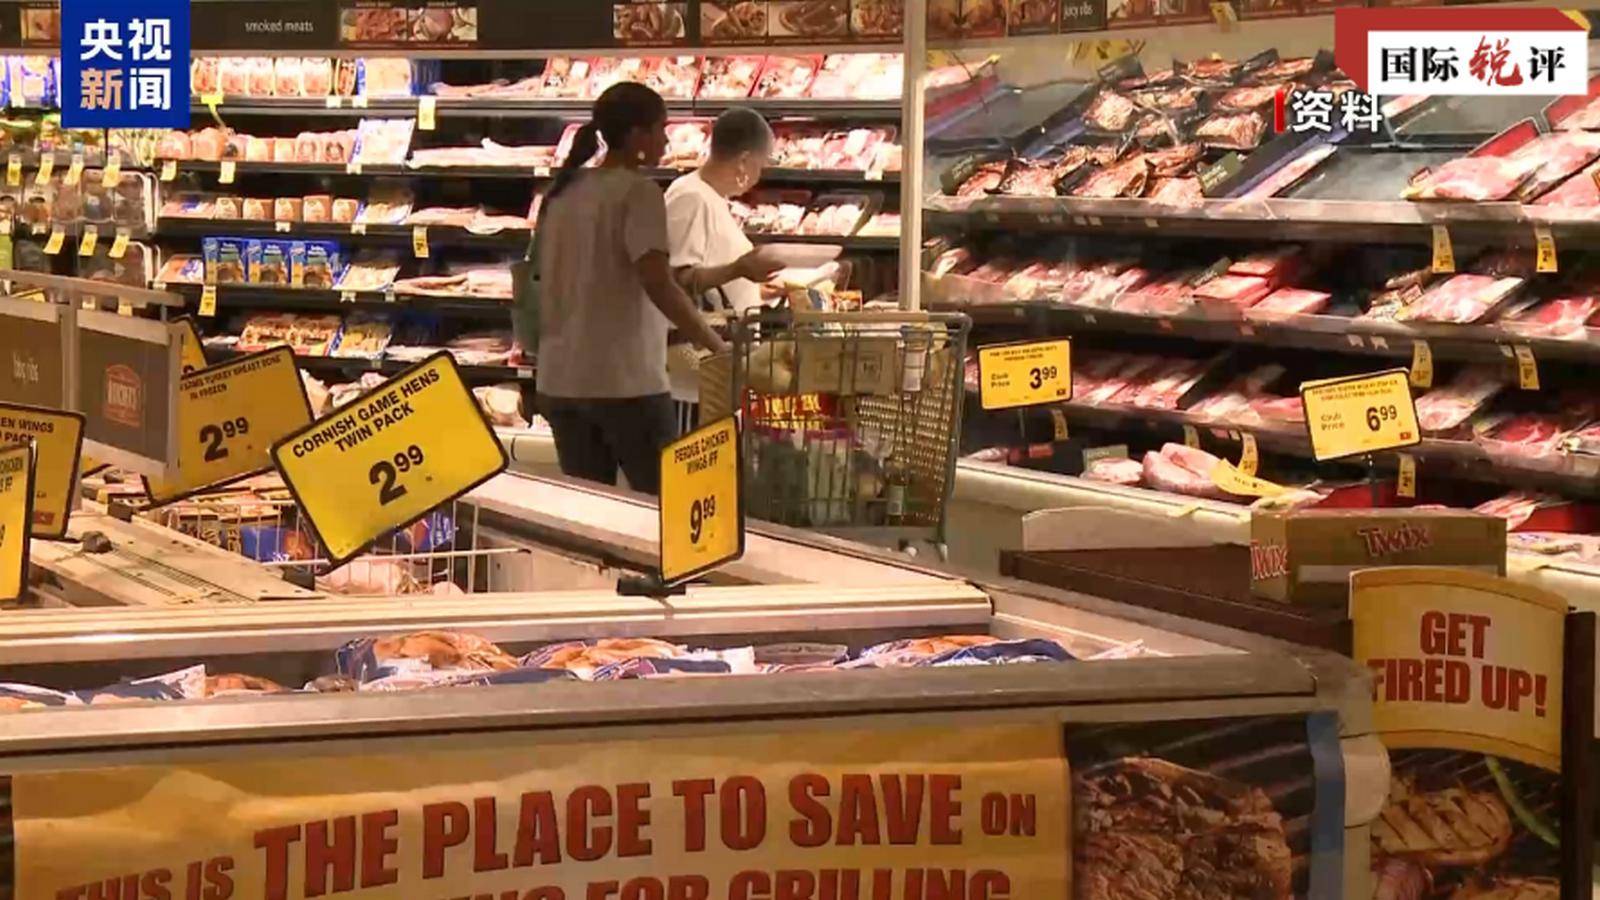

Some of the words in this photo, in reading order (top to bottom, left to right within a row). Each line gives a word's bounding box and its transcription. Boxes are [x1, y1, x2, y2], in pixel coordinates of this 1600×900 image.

[245, 19, 282, 32] smoked
[284, 21, 314, 32] meats
[19, 418, 55, 433] WINGS
[292, 416, 357, 458] CORNISH
[357, 390, 400, 422] GAME
[400, 368, 440, 398] HENS
[334, 427, 373, 452] TWIN
[376, 402, 415, 431] PACK
[1420, 610, 1492, 660] GET
[1367, 658, 1471, 705] FIRED
[1481, 664, 1548, 718] UP!
[186, 856, 235, 900] IS
[253, 808, 400, 900] THE
[422, 781, 653, 880] PLACE
[672, 774, 768, 853] TO
[788, 773, 963, 848] SAVE
[981, 791, 1037, 837] ON
